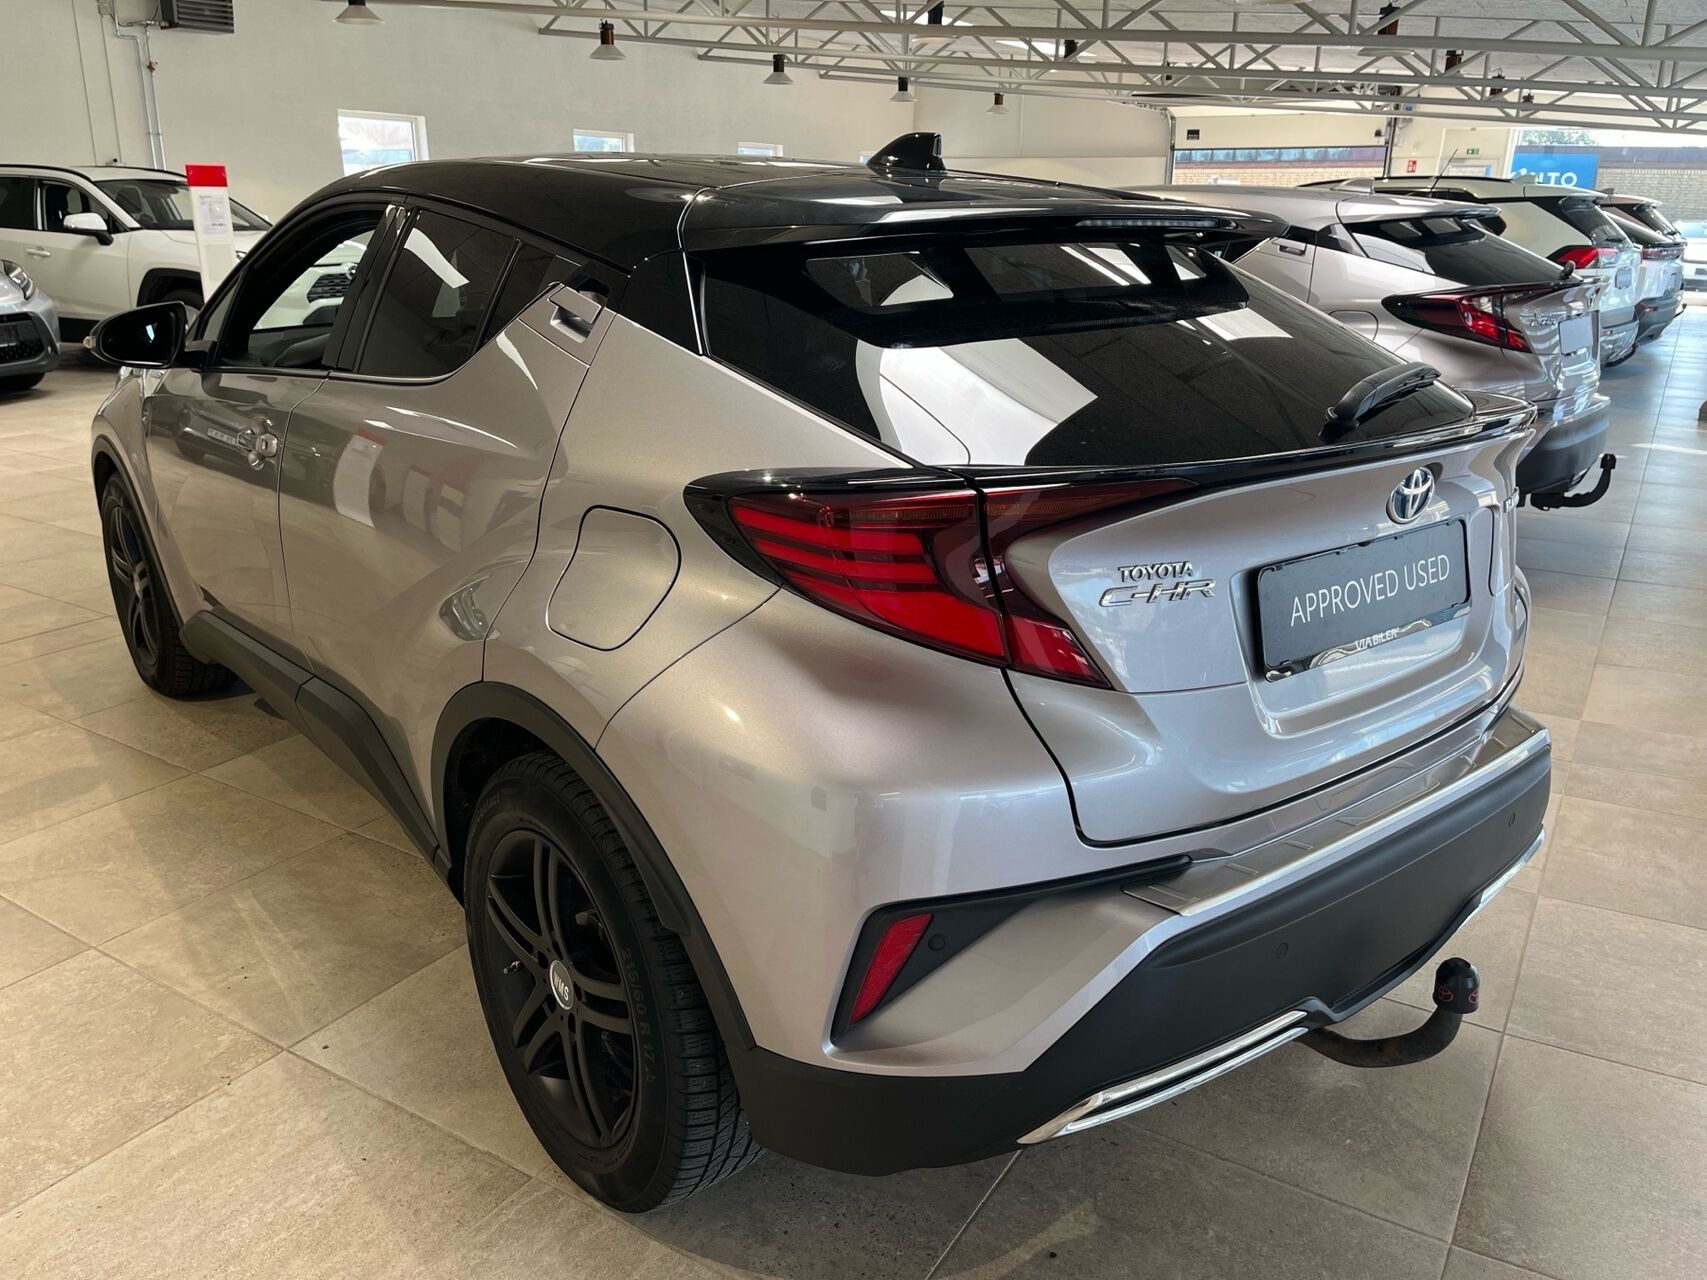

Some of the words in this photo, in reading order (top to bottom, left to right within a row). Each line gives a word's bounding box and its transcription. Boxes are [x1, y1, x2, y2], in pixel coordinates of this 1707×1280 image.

[1530, 171, 1577, 186] UTO
[1118, 561, 1194, 582] TOYOTA
[1099, 579, 1216, 607] C-HR
[1291, 569, 1399, 627] APPROVED
[1404, 554, 1450, 591] USED
[1354, 636, 1372, 651] VIA
[1372, 628, 1397, 646] BILER
